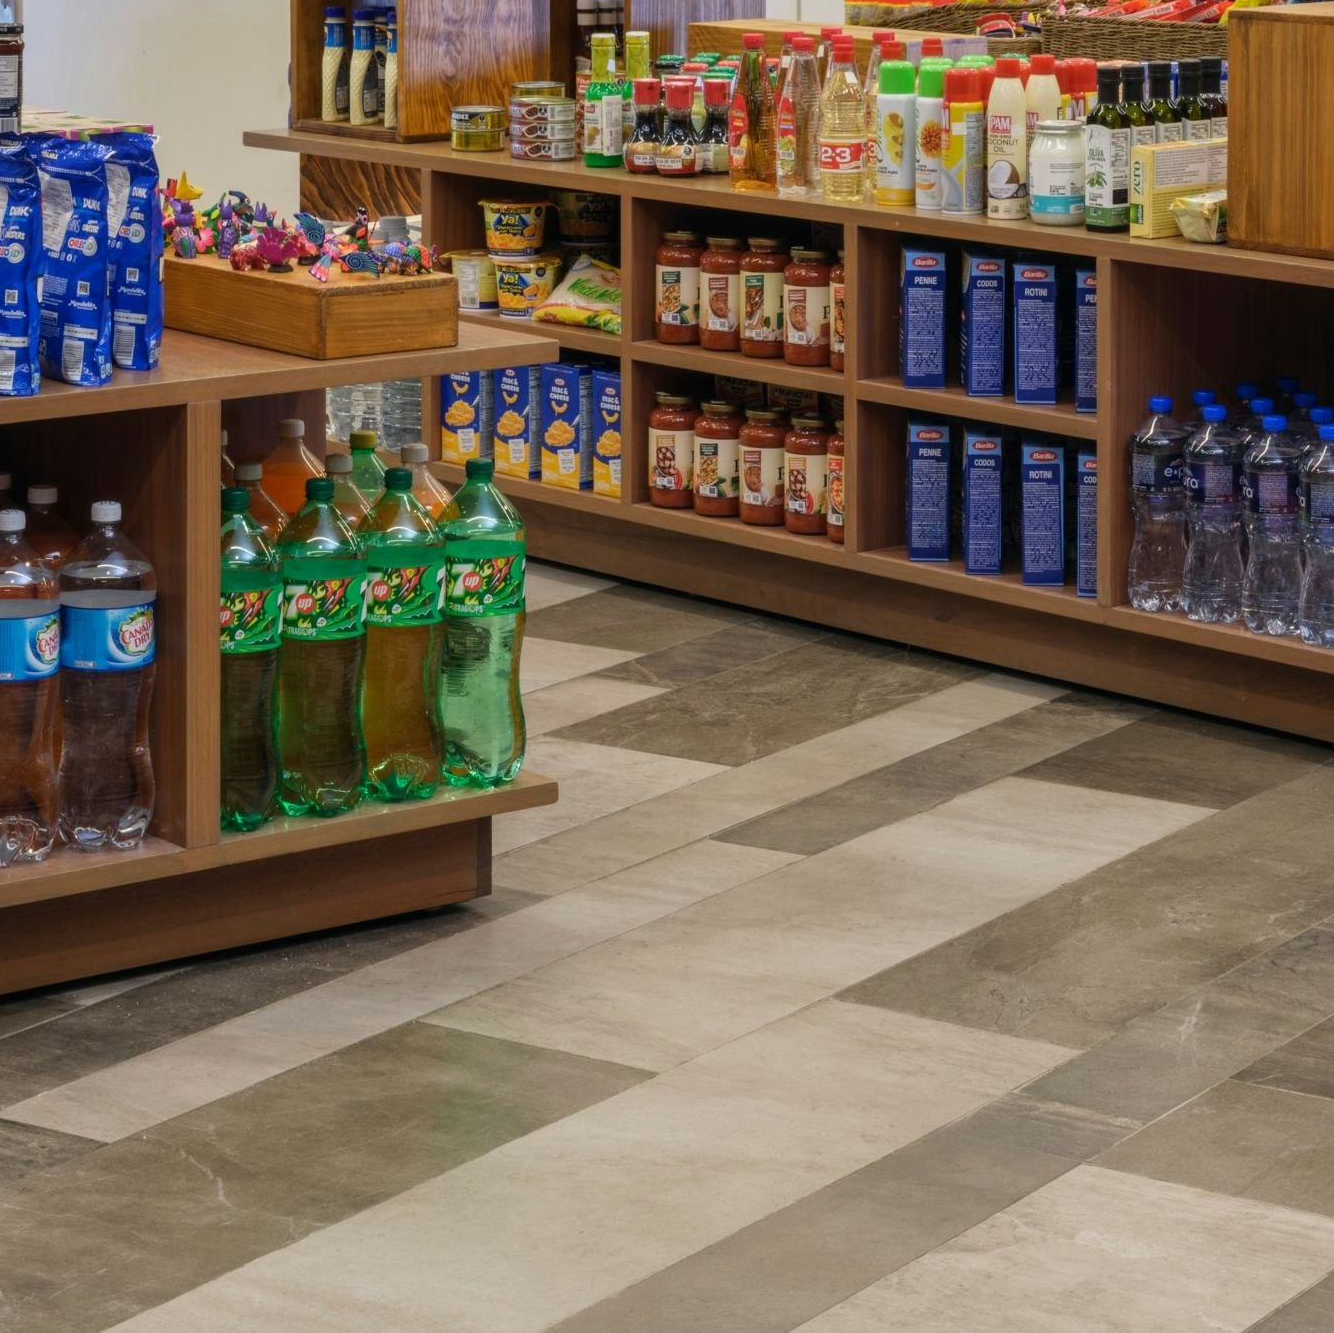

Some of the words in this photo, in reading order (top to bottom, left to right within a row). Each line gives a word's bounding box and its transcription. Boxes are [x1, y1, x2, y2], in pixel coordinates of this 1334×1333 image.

[990, 117, 1011, 131] PAM
[987, 138, 1019, 147] OCONUT
[914, 277, 937, 285] PENNE
[1025, 288, 1047, 297] ROTINI
[919, 449, 941, 457] PENNE
[974, 459, 995, 467] CODOS
[1029, 471, 1052, 479] ROTINI
[134, 632, 150, 649] DRY
